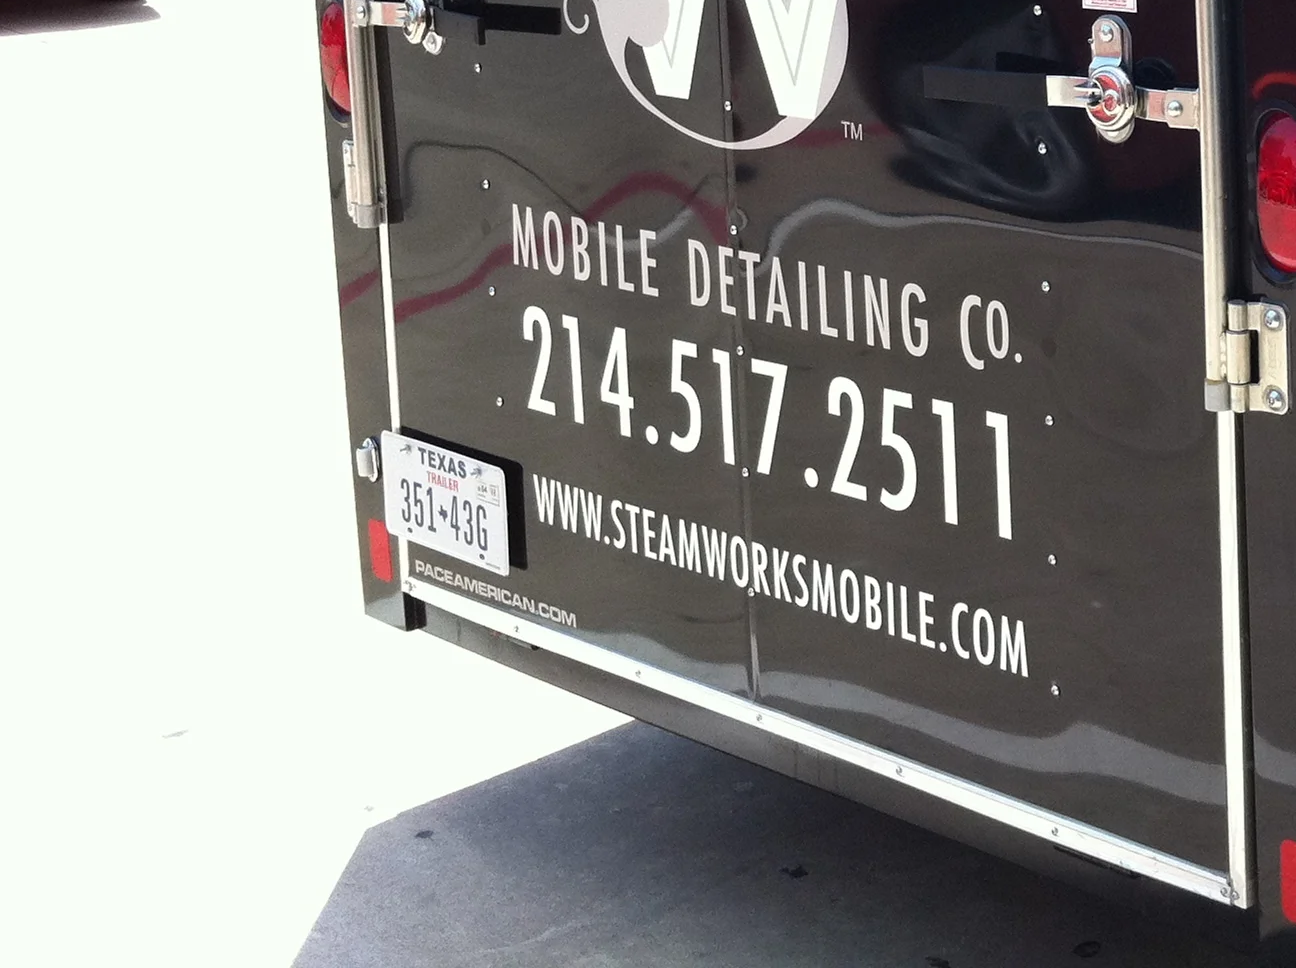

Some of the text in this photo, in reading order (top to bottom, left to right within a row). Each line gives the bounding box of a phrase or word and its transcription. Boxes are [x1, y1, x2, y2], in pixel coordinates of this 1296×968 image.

[841, 120, 864, 142] TM
[511, 203, 1023, 371] MOBILE DETAILING CO.
[522, 305, 1013, 541] 214.517.2511
[417, 446, 468, 479] TEXAS
[426, 470, 460, 493] TRAILER
[414, 559, 578, 629] PACEAMERICAN.COM
[532, 473, 1030, 679] WWW.STEAMWORKSMOBILE.COM
